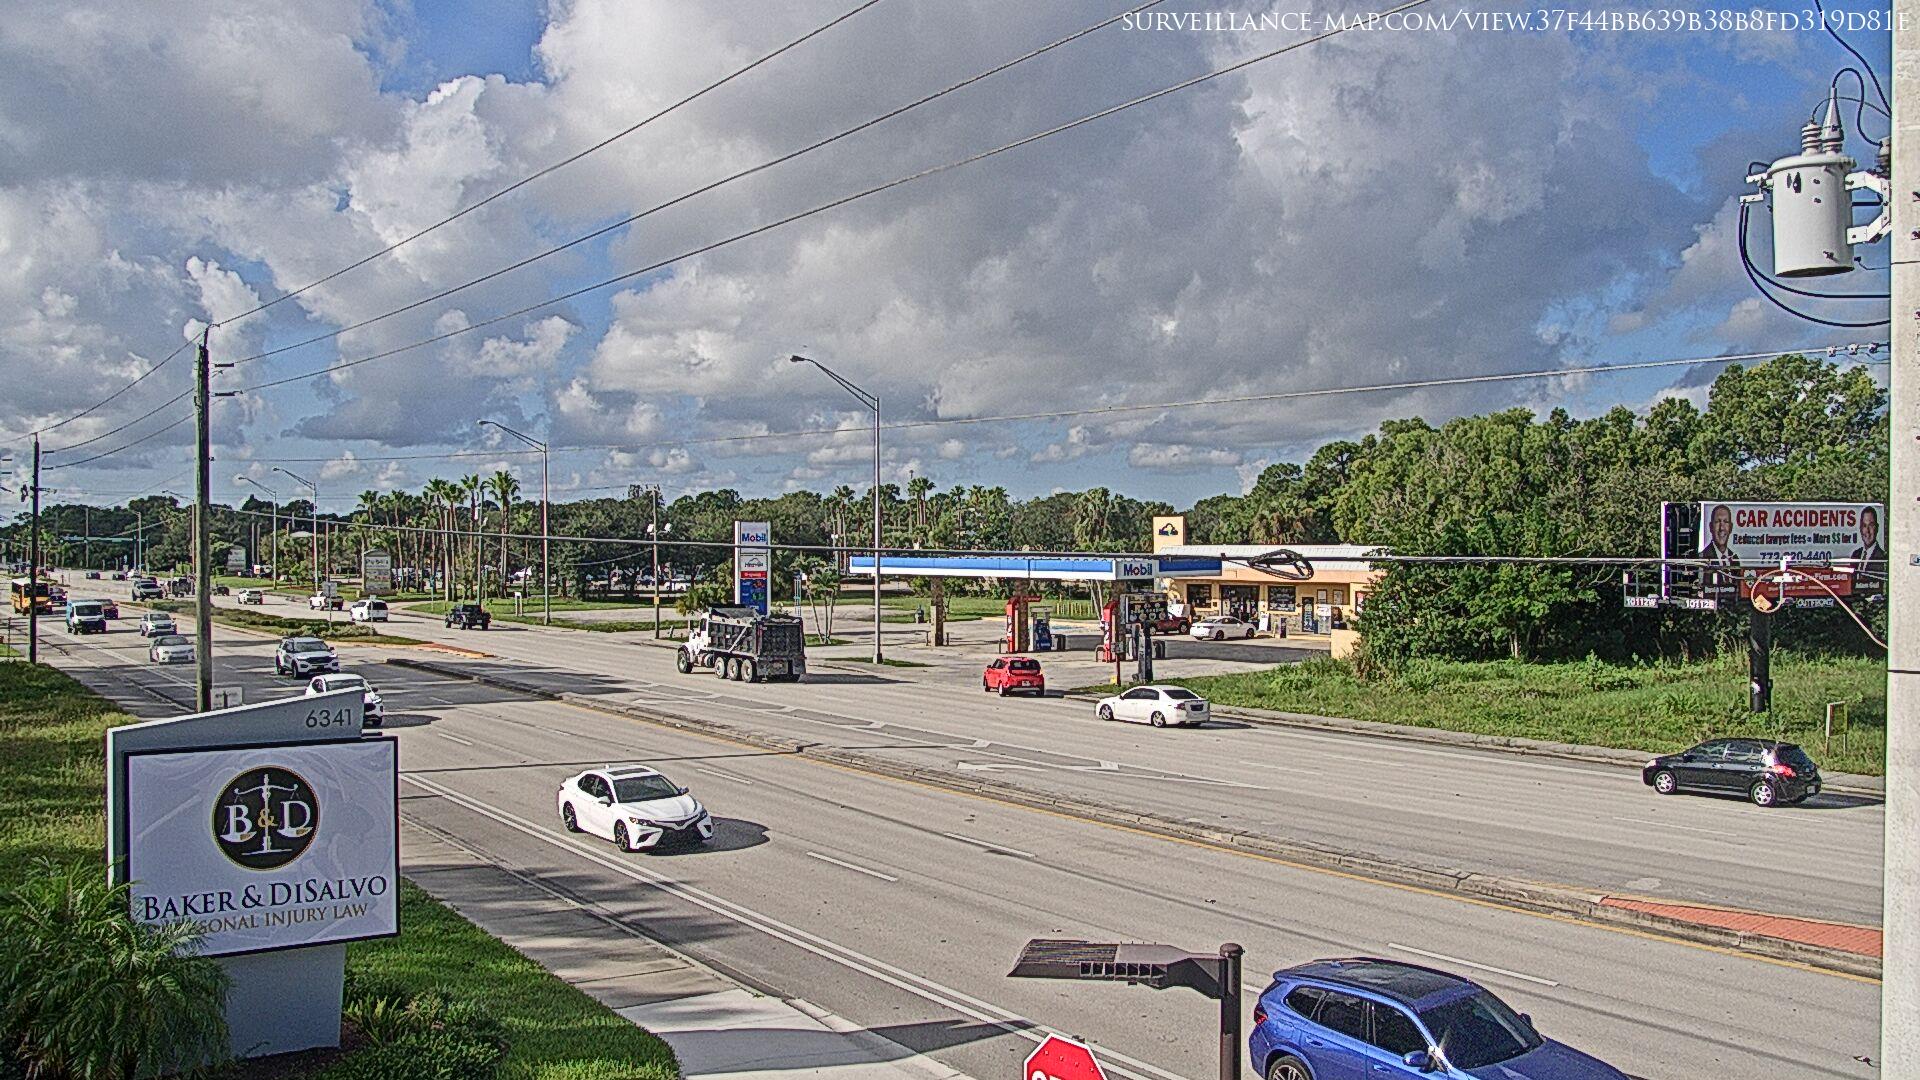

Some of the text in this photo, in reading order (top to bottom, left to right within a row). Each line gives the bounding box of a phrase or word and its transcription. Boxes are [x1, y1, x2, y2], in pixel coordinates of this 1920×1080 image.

[1736, 509, 1857, 528] CAR ACCIDENTS
[741, 532, 767, 542] Mobil
[1123, 562, 1153, 577] Mobil
[305, 708, 352, 729] 6341
[143, 891, 237, 922] BAKER
[240, 884, 264, 910] &
[264, 906, 329, 928] INJURY
[332, 902, 369, 919] LAW
